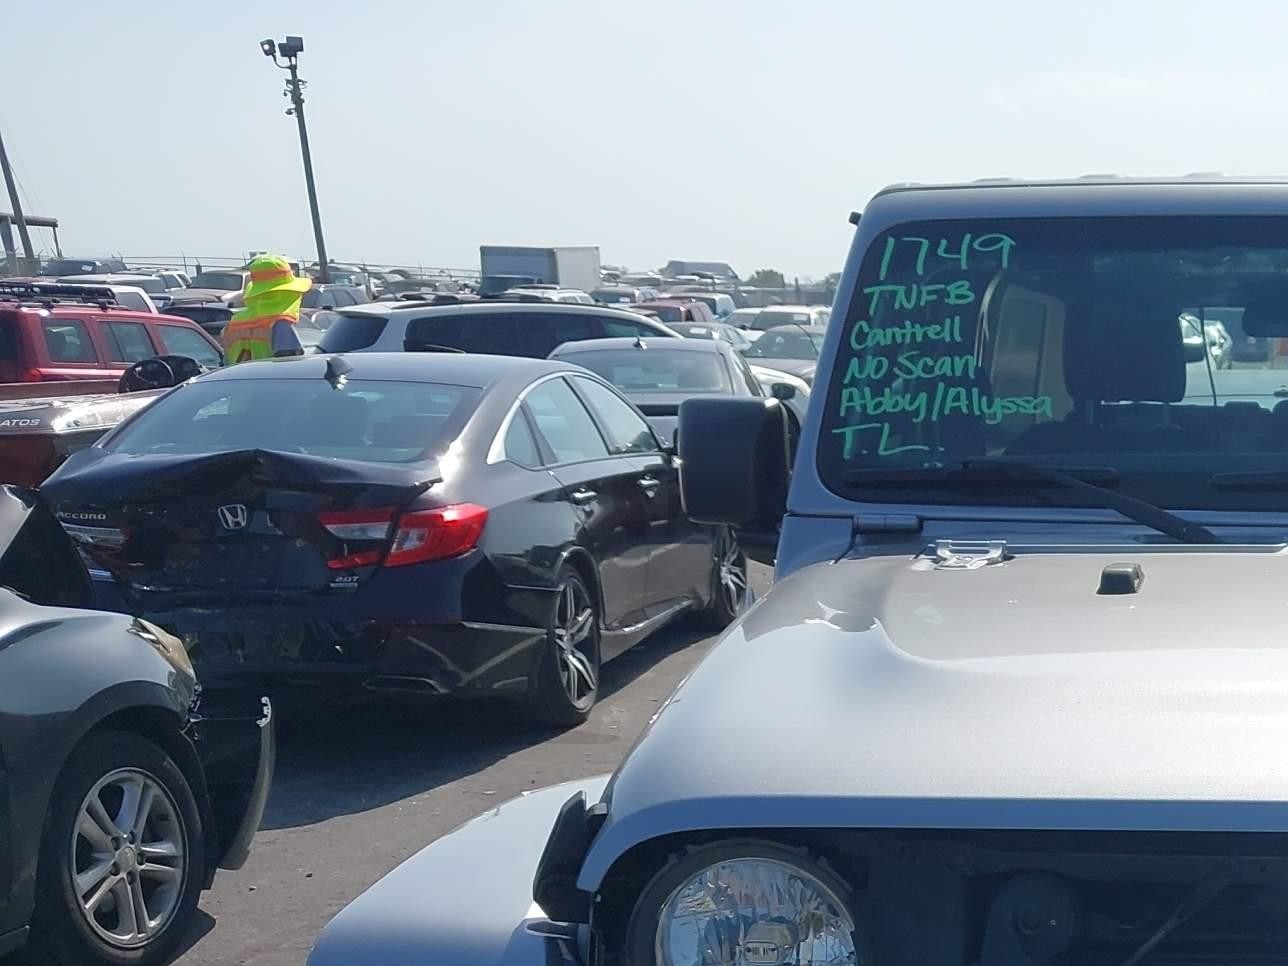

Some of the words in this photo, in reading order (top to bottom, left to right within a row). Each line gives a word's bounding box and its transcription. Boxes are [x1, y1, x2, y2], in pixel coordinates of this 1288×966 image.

[879, 233, 1016, 280] 1749
[851, 316, 962, 350] Cantrell
[893, 351, 976, 380] Scan
[840, 382, 1053, 425] Abby/Alyssa
